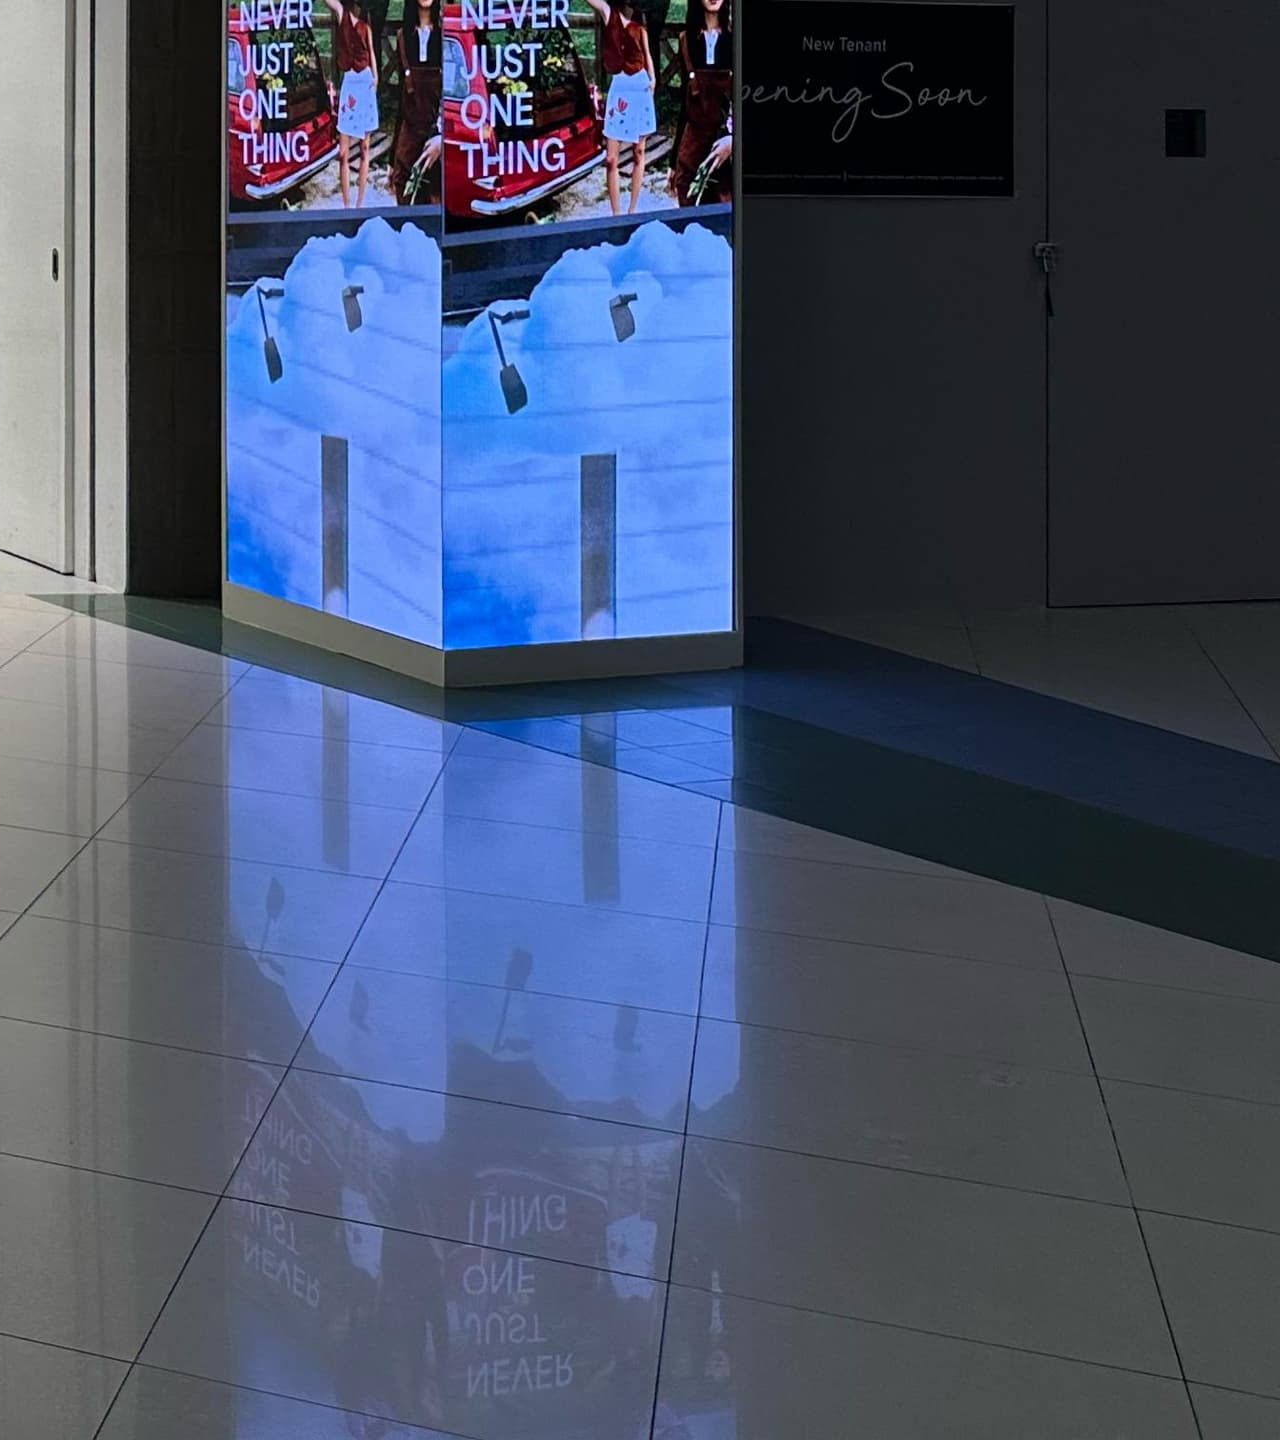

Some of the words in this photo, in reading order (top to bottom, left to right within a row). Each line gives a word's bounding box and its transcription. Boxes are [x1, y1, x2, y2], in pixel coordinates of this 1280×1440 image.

[239, 42, 294, 76] JUST
[460, 42, 543, 80] JUST
[802, 35, 835, 53] New
[839, 36, 888, 53] Tenant
[239, 87, 288, 121] ONE
[870, 62, 988, 119] Soon
[460, 91, 534, 130] ONE
[239, 130, 310, 165] THING
[460, 136, 566, 179] THING
